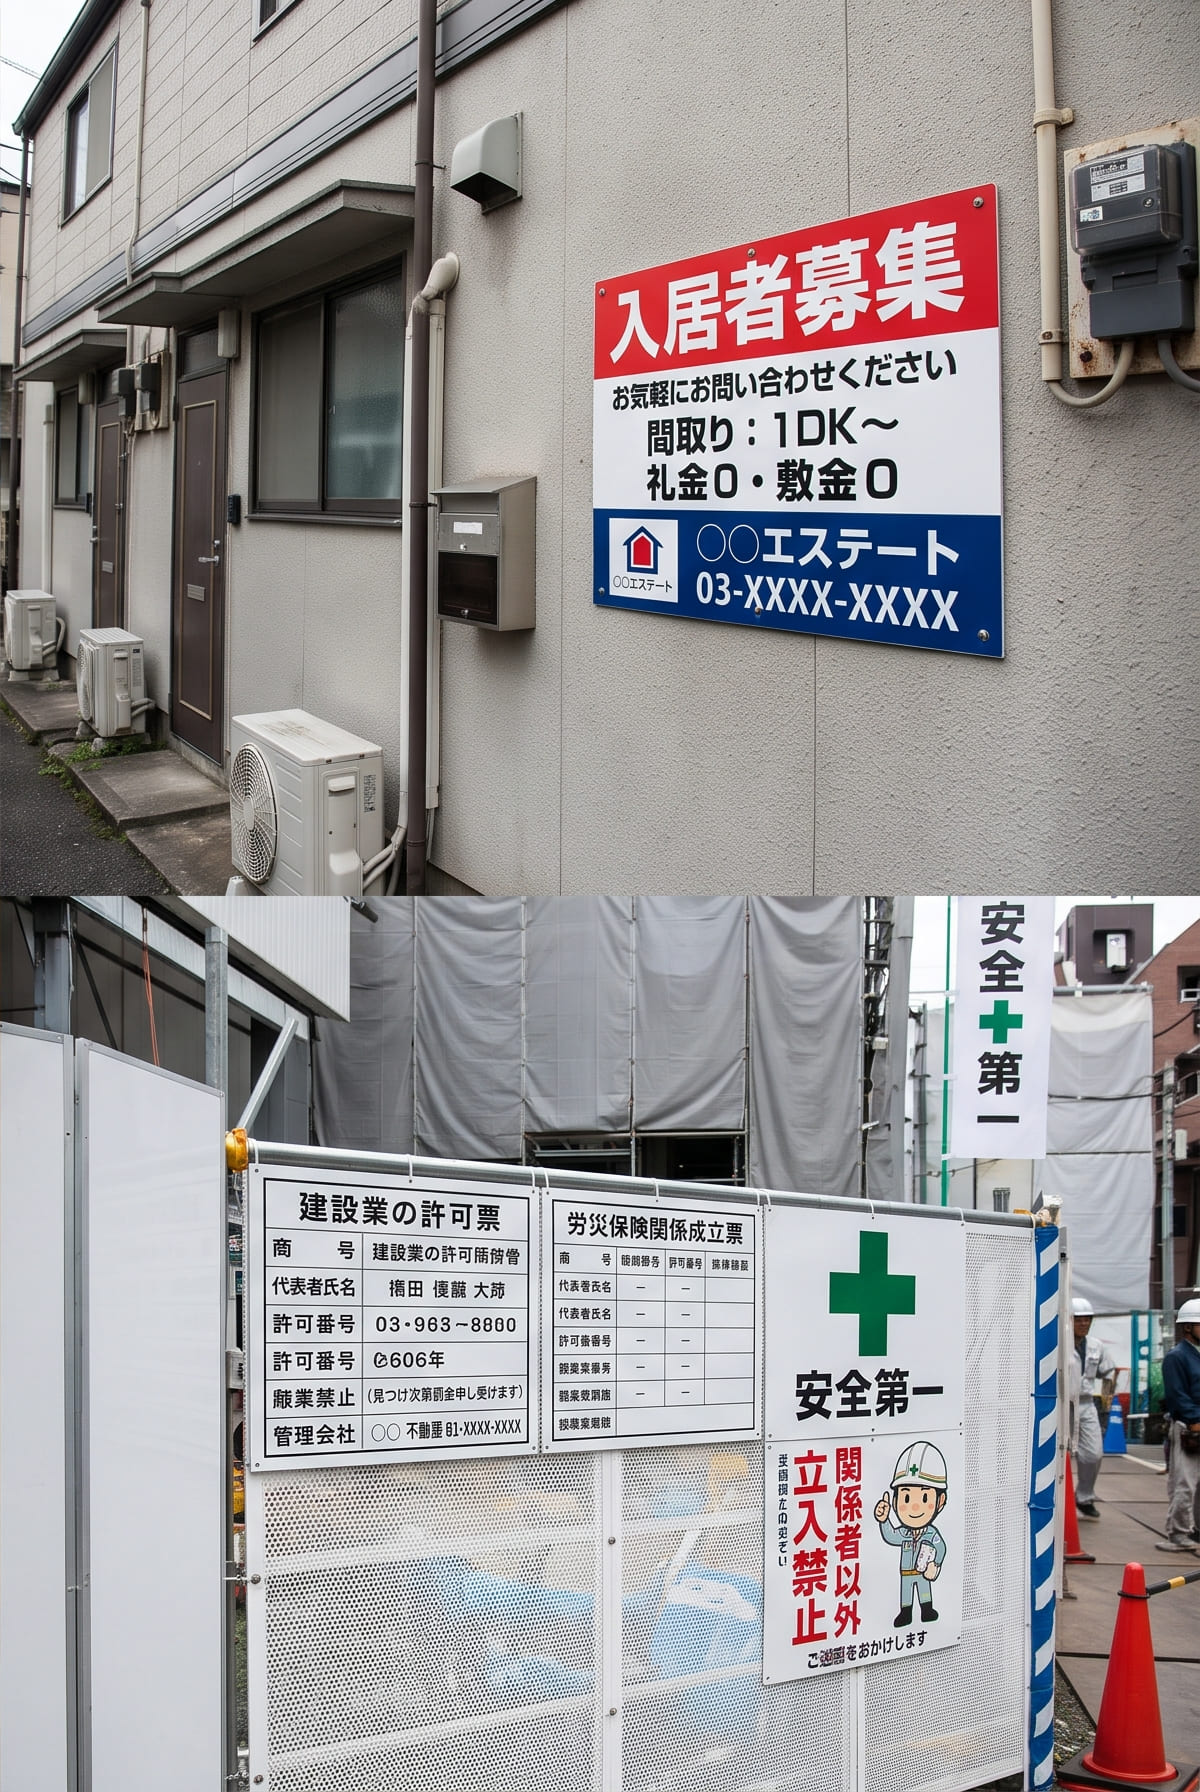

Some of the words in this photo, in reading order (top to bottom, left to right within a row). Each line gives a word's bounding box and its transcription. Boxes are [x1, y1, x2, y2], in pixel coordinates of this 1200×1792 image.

[609, 221, 965, 364] 入居者募集
[612, 349, 957, 411] お気軽にお問い合わせください
[696, 571, 960, 632] 03-XXXX-XXXX
[299, 1192, 501, 1232] 建設業の許可票
[567, 1211, 744, 1246] 労災保険関係成立票
[272, 1276, 356, 1297] 代表者氏名
[273, 1313, 356, 1335] 許可番号
[273, 1350, 356, 1371] 許可番号
[795, 1368, 944, 1421] 安全第一
[273, 1424, 356, 1447] 管理会社
[792, 1449, 828, 1646] 立入禁止
[834, 1446, 862, 1639] 関係者以外
